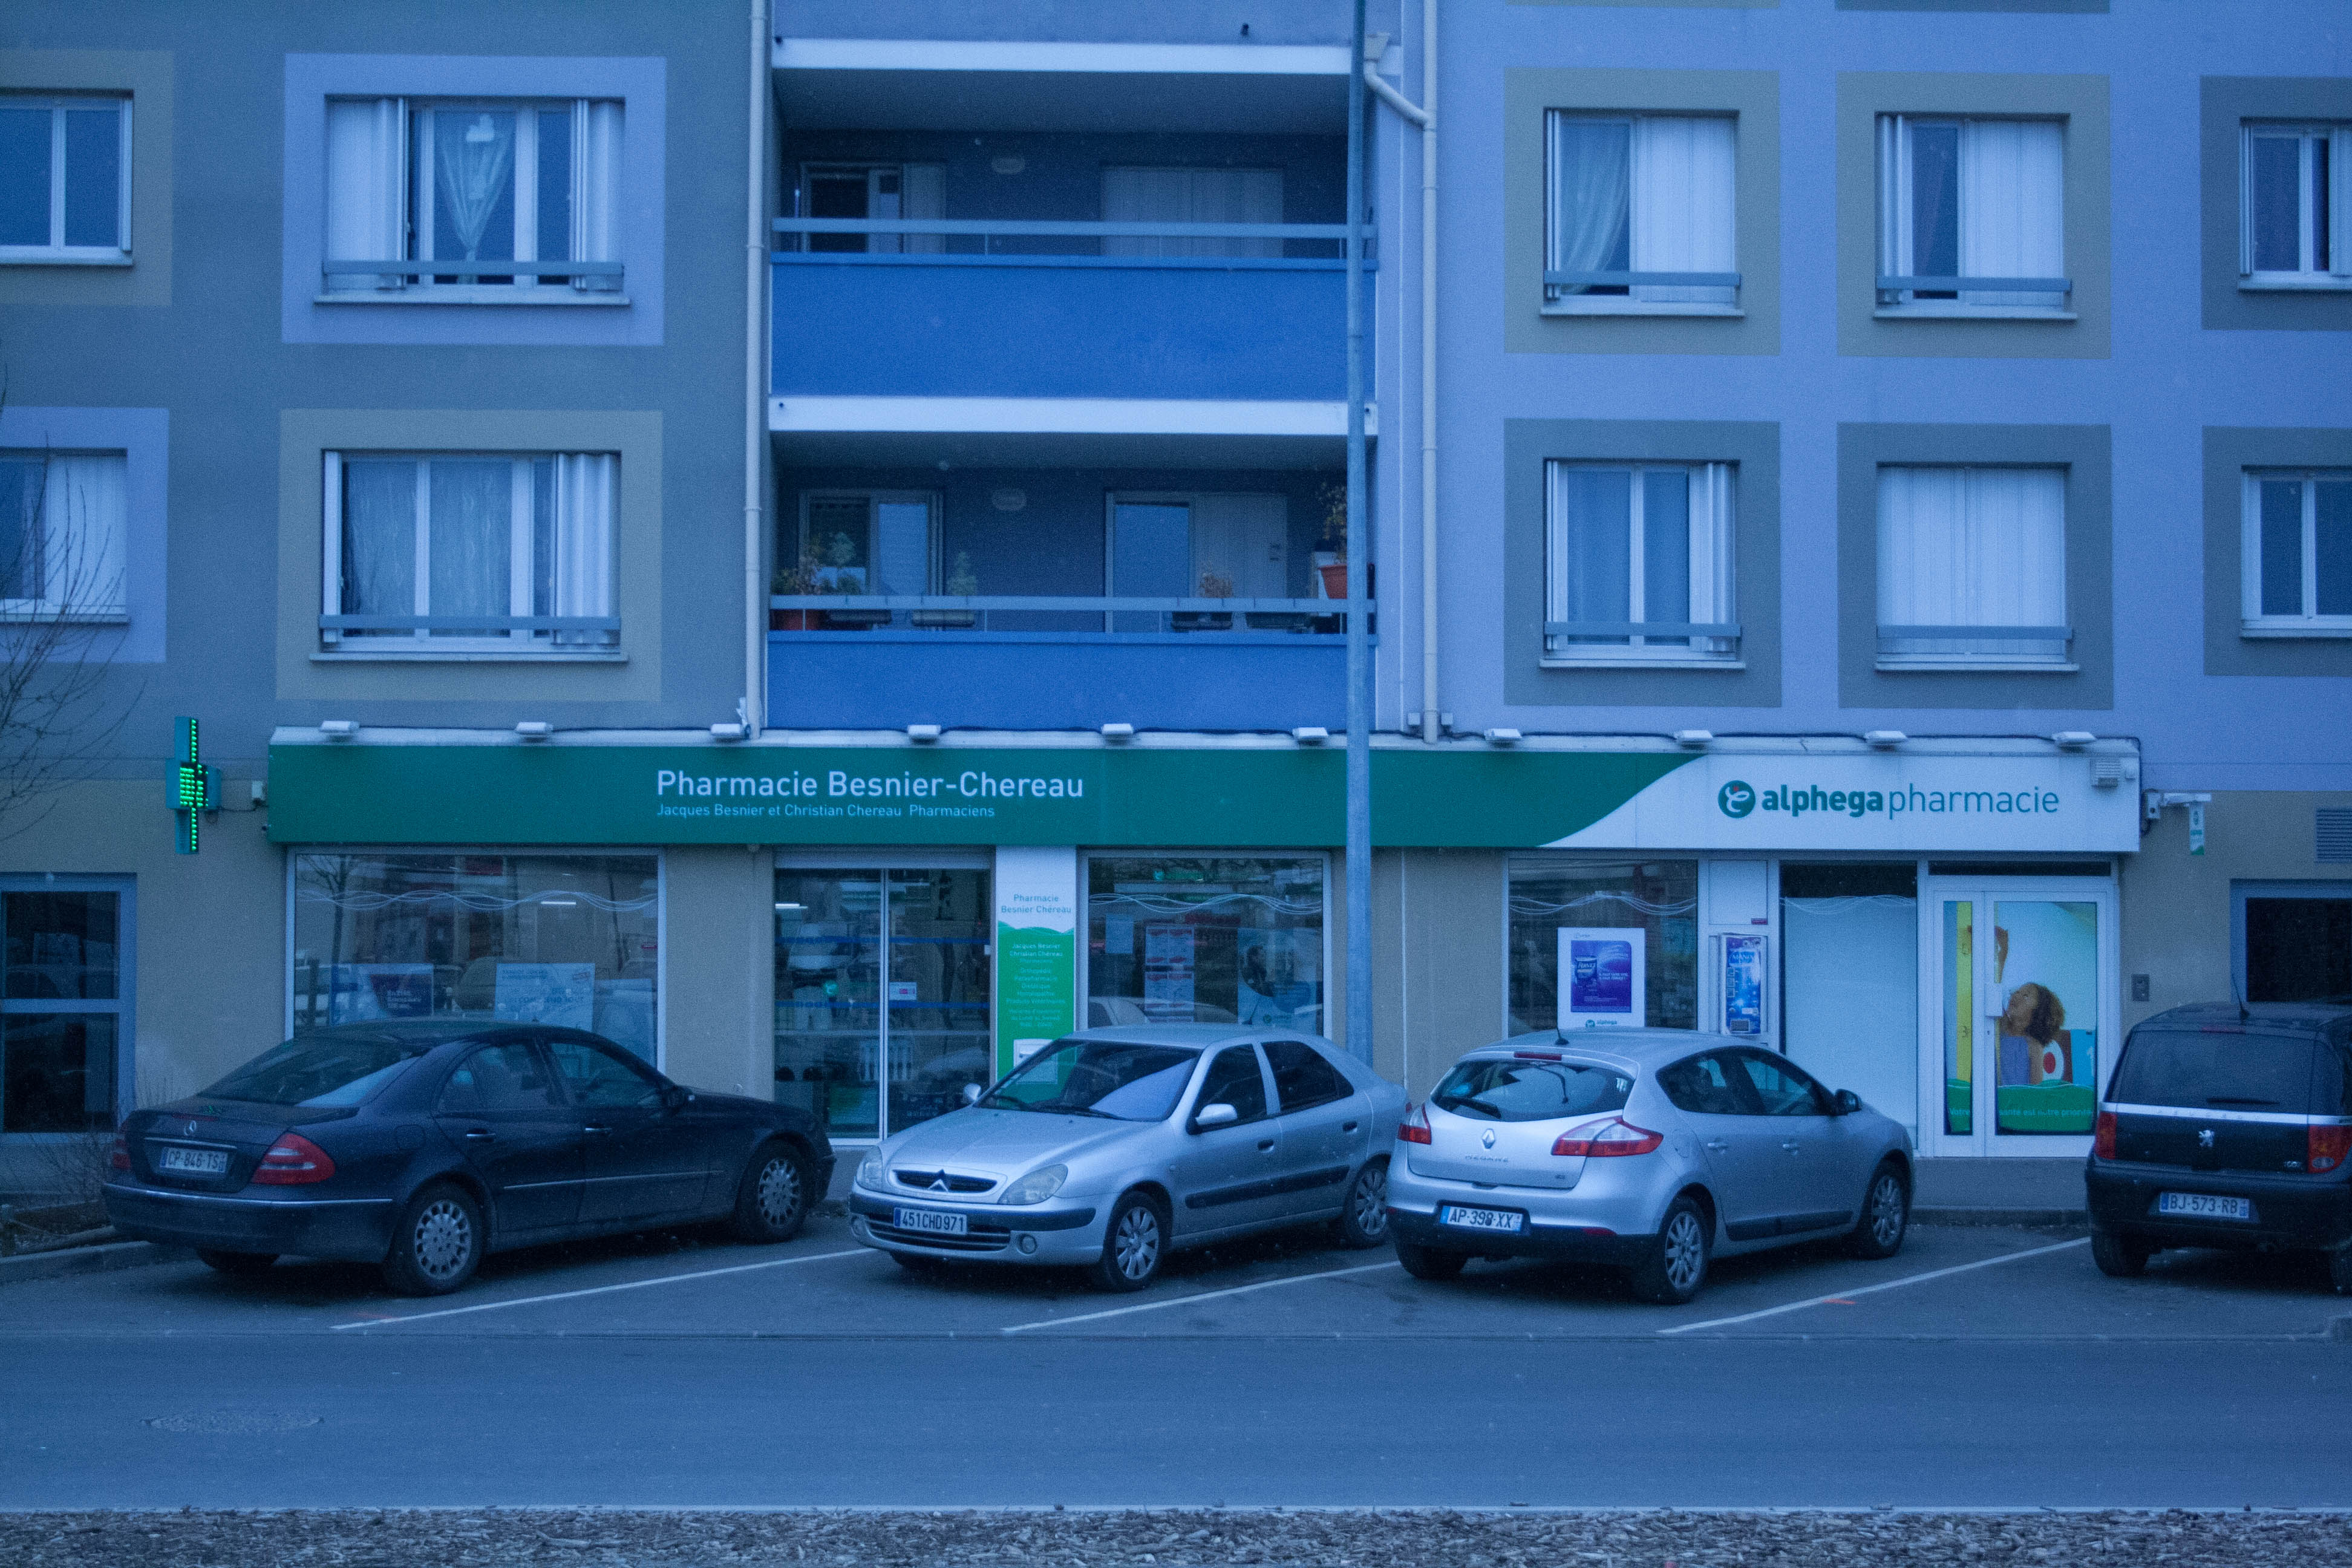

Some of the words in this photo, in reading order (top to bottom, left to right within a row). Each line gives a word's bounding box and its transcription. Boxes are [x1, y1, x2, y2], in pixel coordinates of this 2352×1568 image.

[657, 770, 818, 797] Pharmacie
[828, 771, 1084, 797] Besnier-Chereau
[657, 803, 710, 818] Jacques
[714, 804, 765, 817] Besnier
[768, 805, 781, 816] et
[785, 804, 844, 817] Christian
[847, 805, 902, 817] Chereau
[909, 805, 995, 817] Pharmaciens
[1761, 785, 1883, 817] alphega
[1888, 783, 2059, 819] pharmacie
[2169, 1194, 2238, 1215] BJ-573-RB
